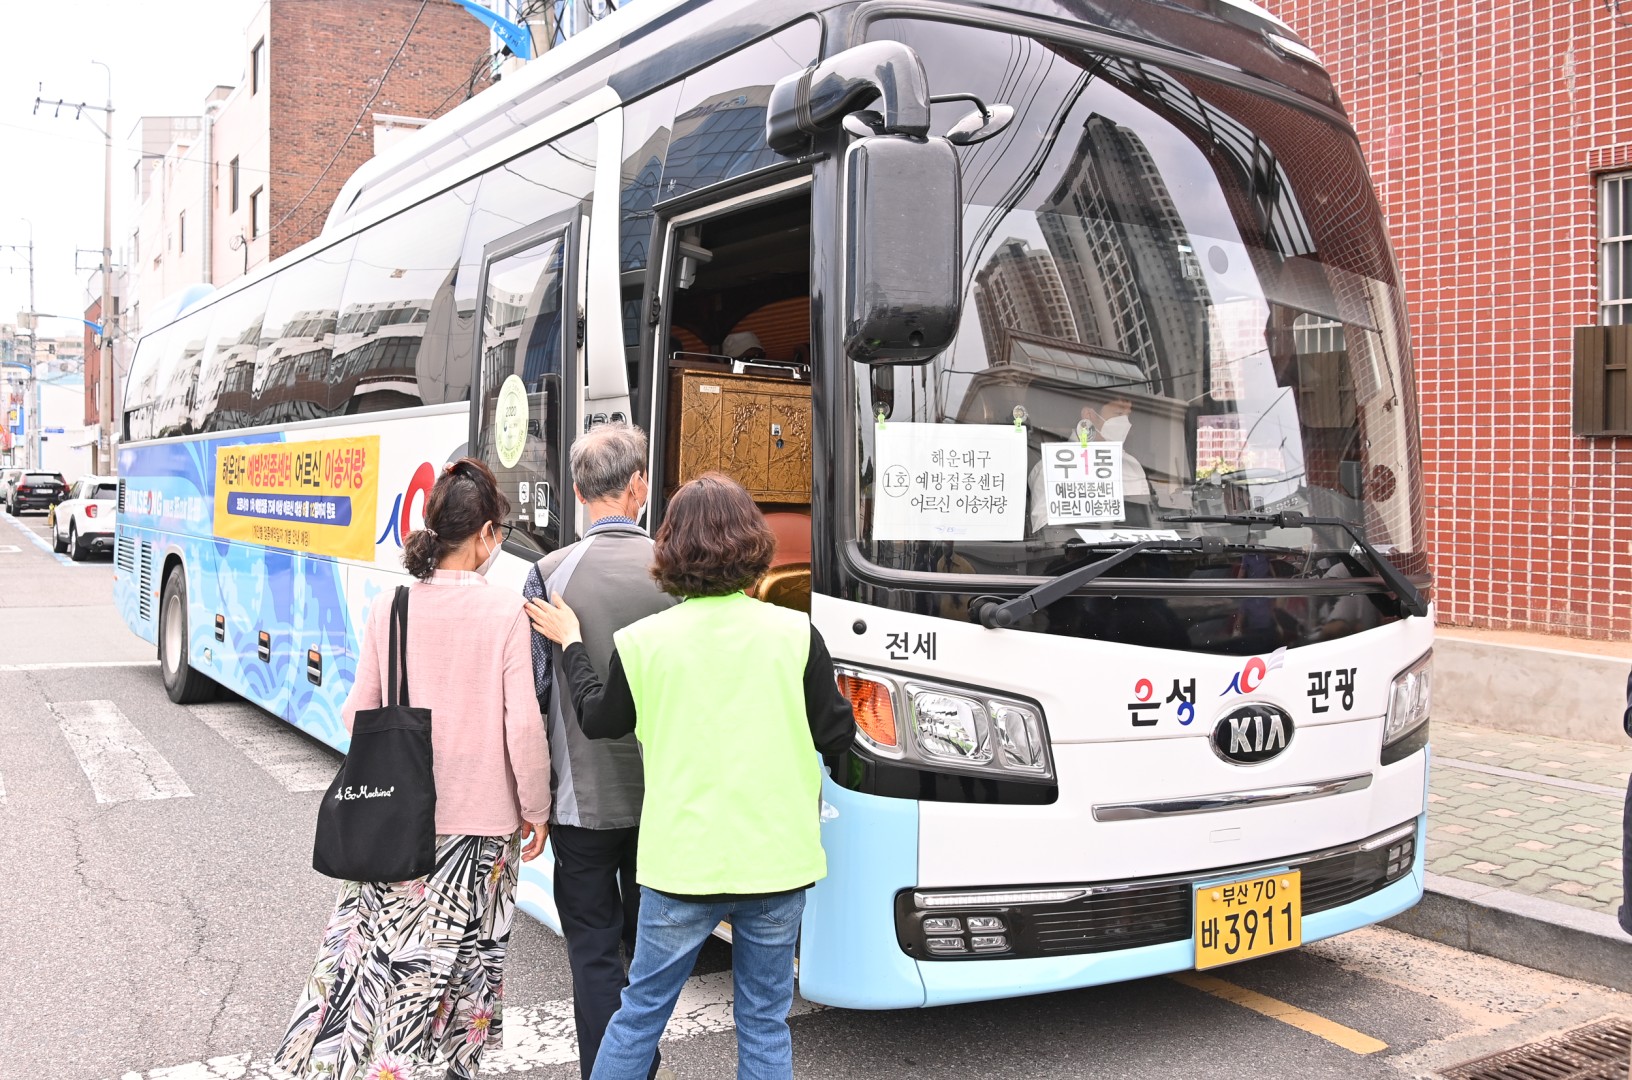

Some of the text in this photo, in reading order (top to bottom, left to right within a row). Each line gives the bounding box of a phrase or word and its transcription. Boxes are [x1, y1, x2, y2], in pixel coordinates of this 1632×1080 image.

[222, 447, 366, 490] 해운대구 예방접종센터 어르신 이송차량
[931, 449, 992, 469] 해운대구
[1054, 449, 1114, 479] 우1동
[915, 470, 1005, 492] 예방접종센터
[1055, 481, 1115, 499] 예방접종센터
[910, 493, 1008, 515] 어르신 이송차량
[1050, 499, 1121, 517] 어르신 이송차량
[885, 631, 937, 661] 전세
[1128, 667, 1358, 727] 은성 관광
[1229, 714, 1286, 754] KIA
